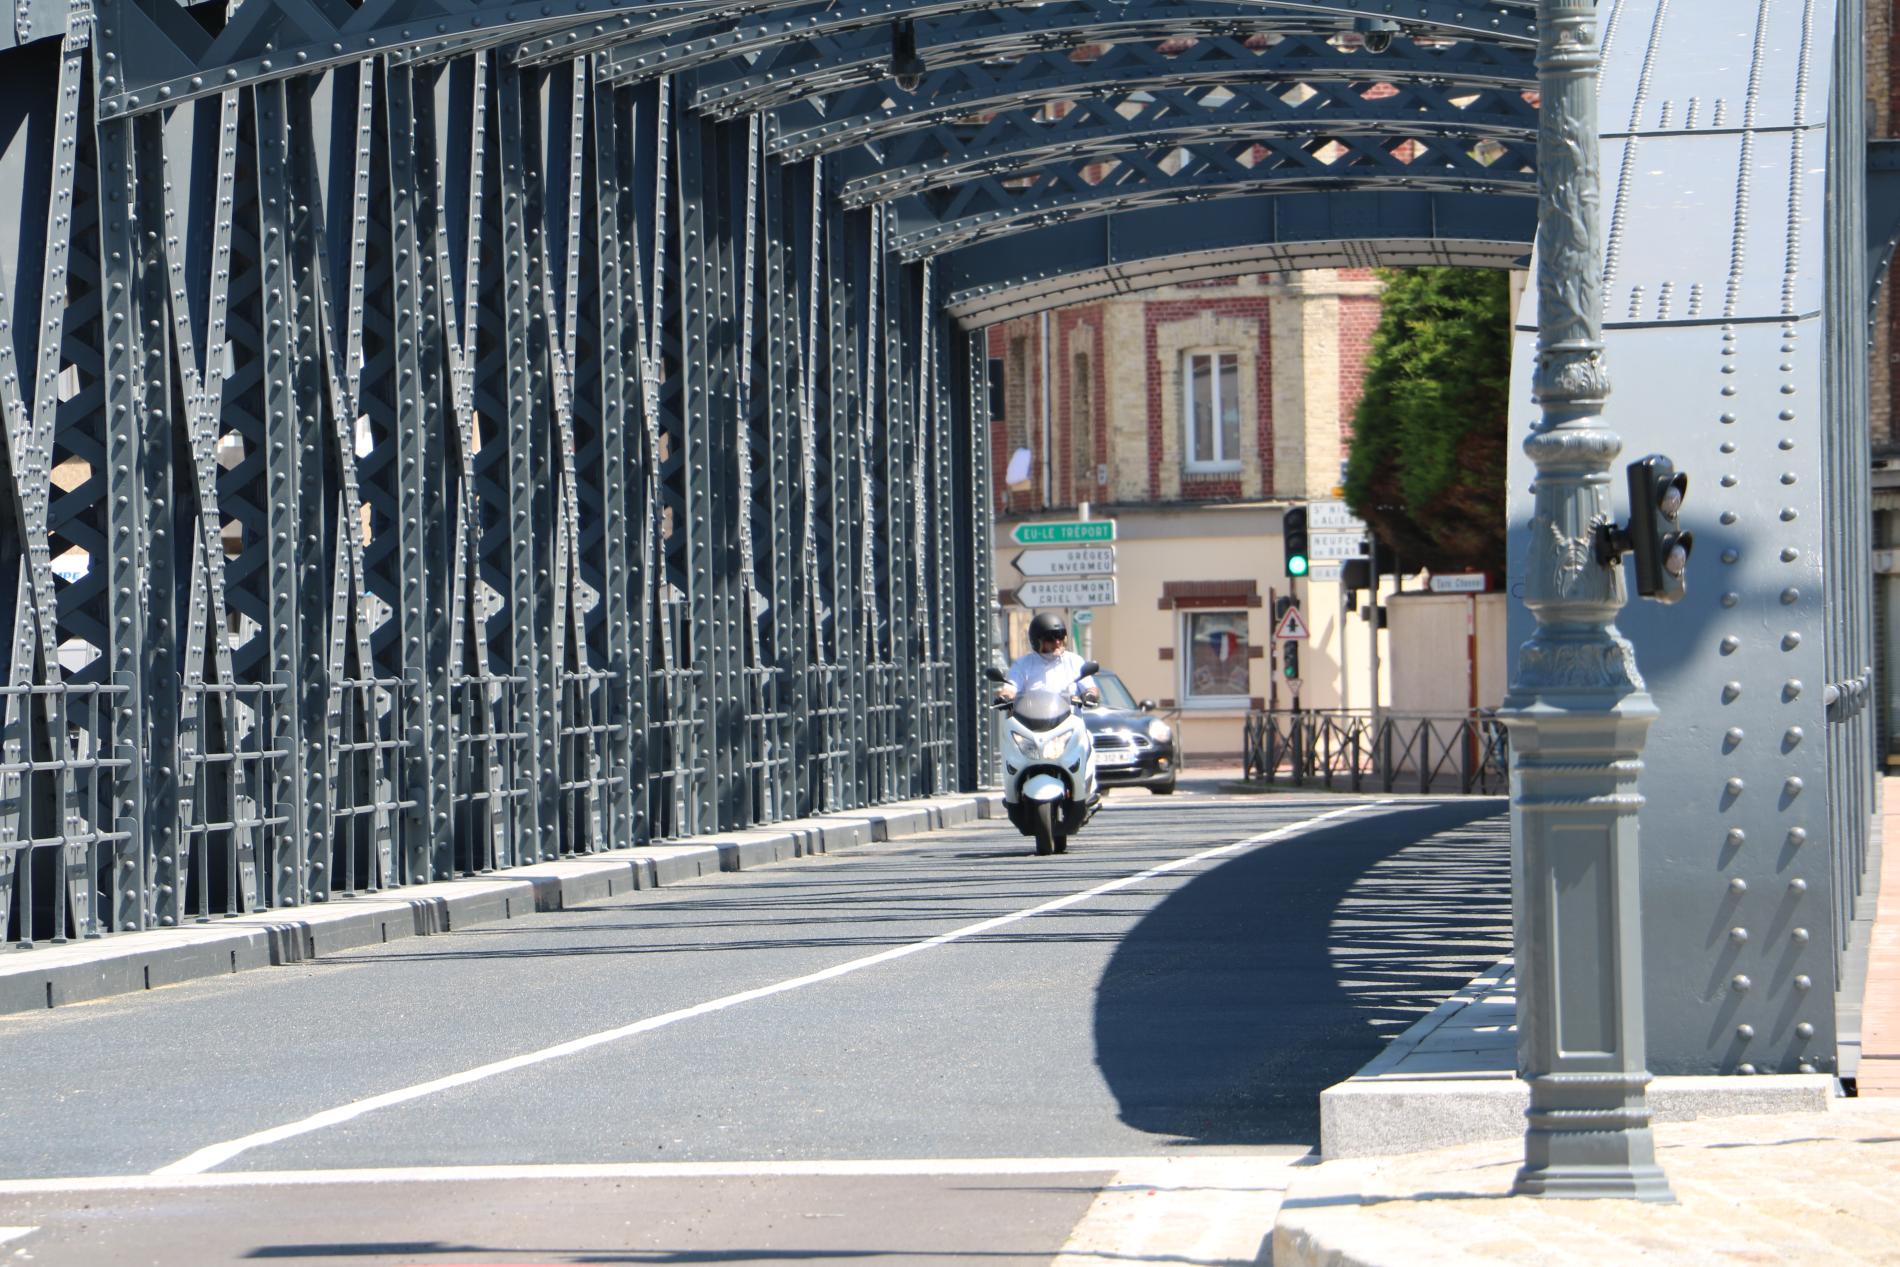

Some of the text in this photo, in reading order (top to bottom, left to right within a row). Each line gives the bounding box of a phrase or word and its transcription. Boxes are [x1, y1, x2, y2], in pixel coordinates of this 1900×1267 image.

[1024, 525, 1108, 539] EU-LE TRÉPORT
[1314, 536, 1359, 545] NEUFCH
[1051, 562, 1110, 572] ENVERMEU
[1031, 582, 1110, 594] BRACQUEMONT
[1040, 594, 1071, 604] CRIEL
[1088, 592, 1110, 602] MER
